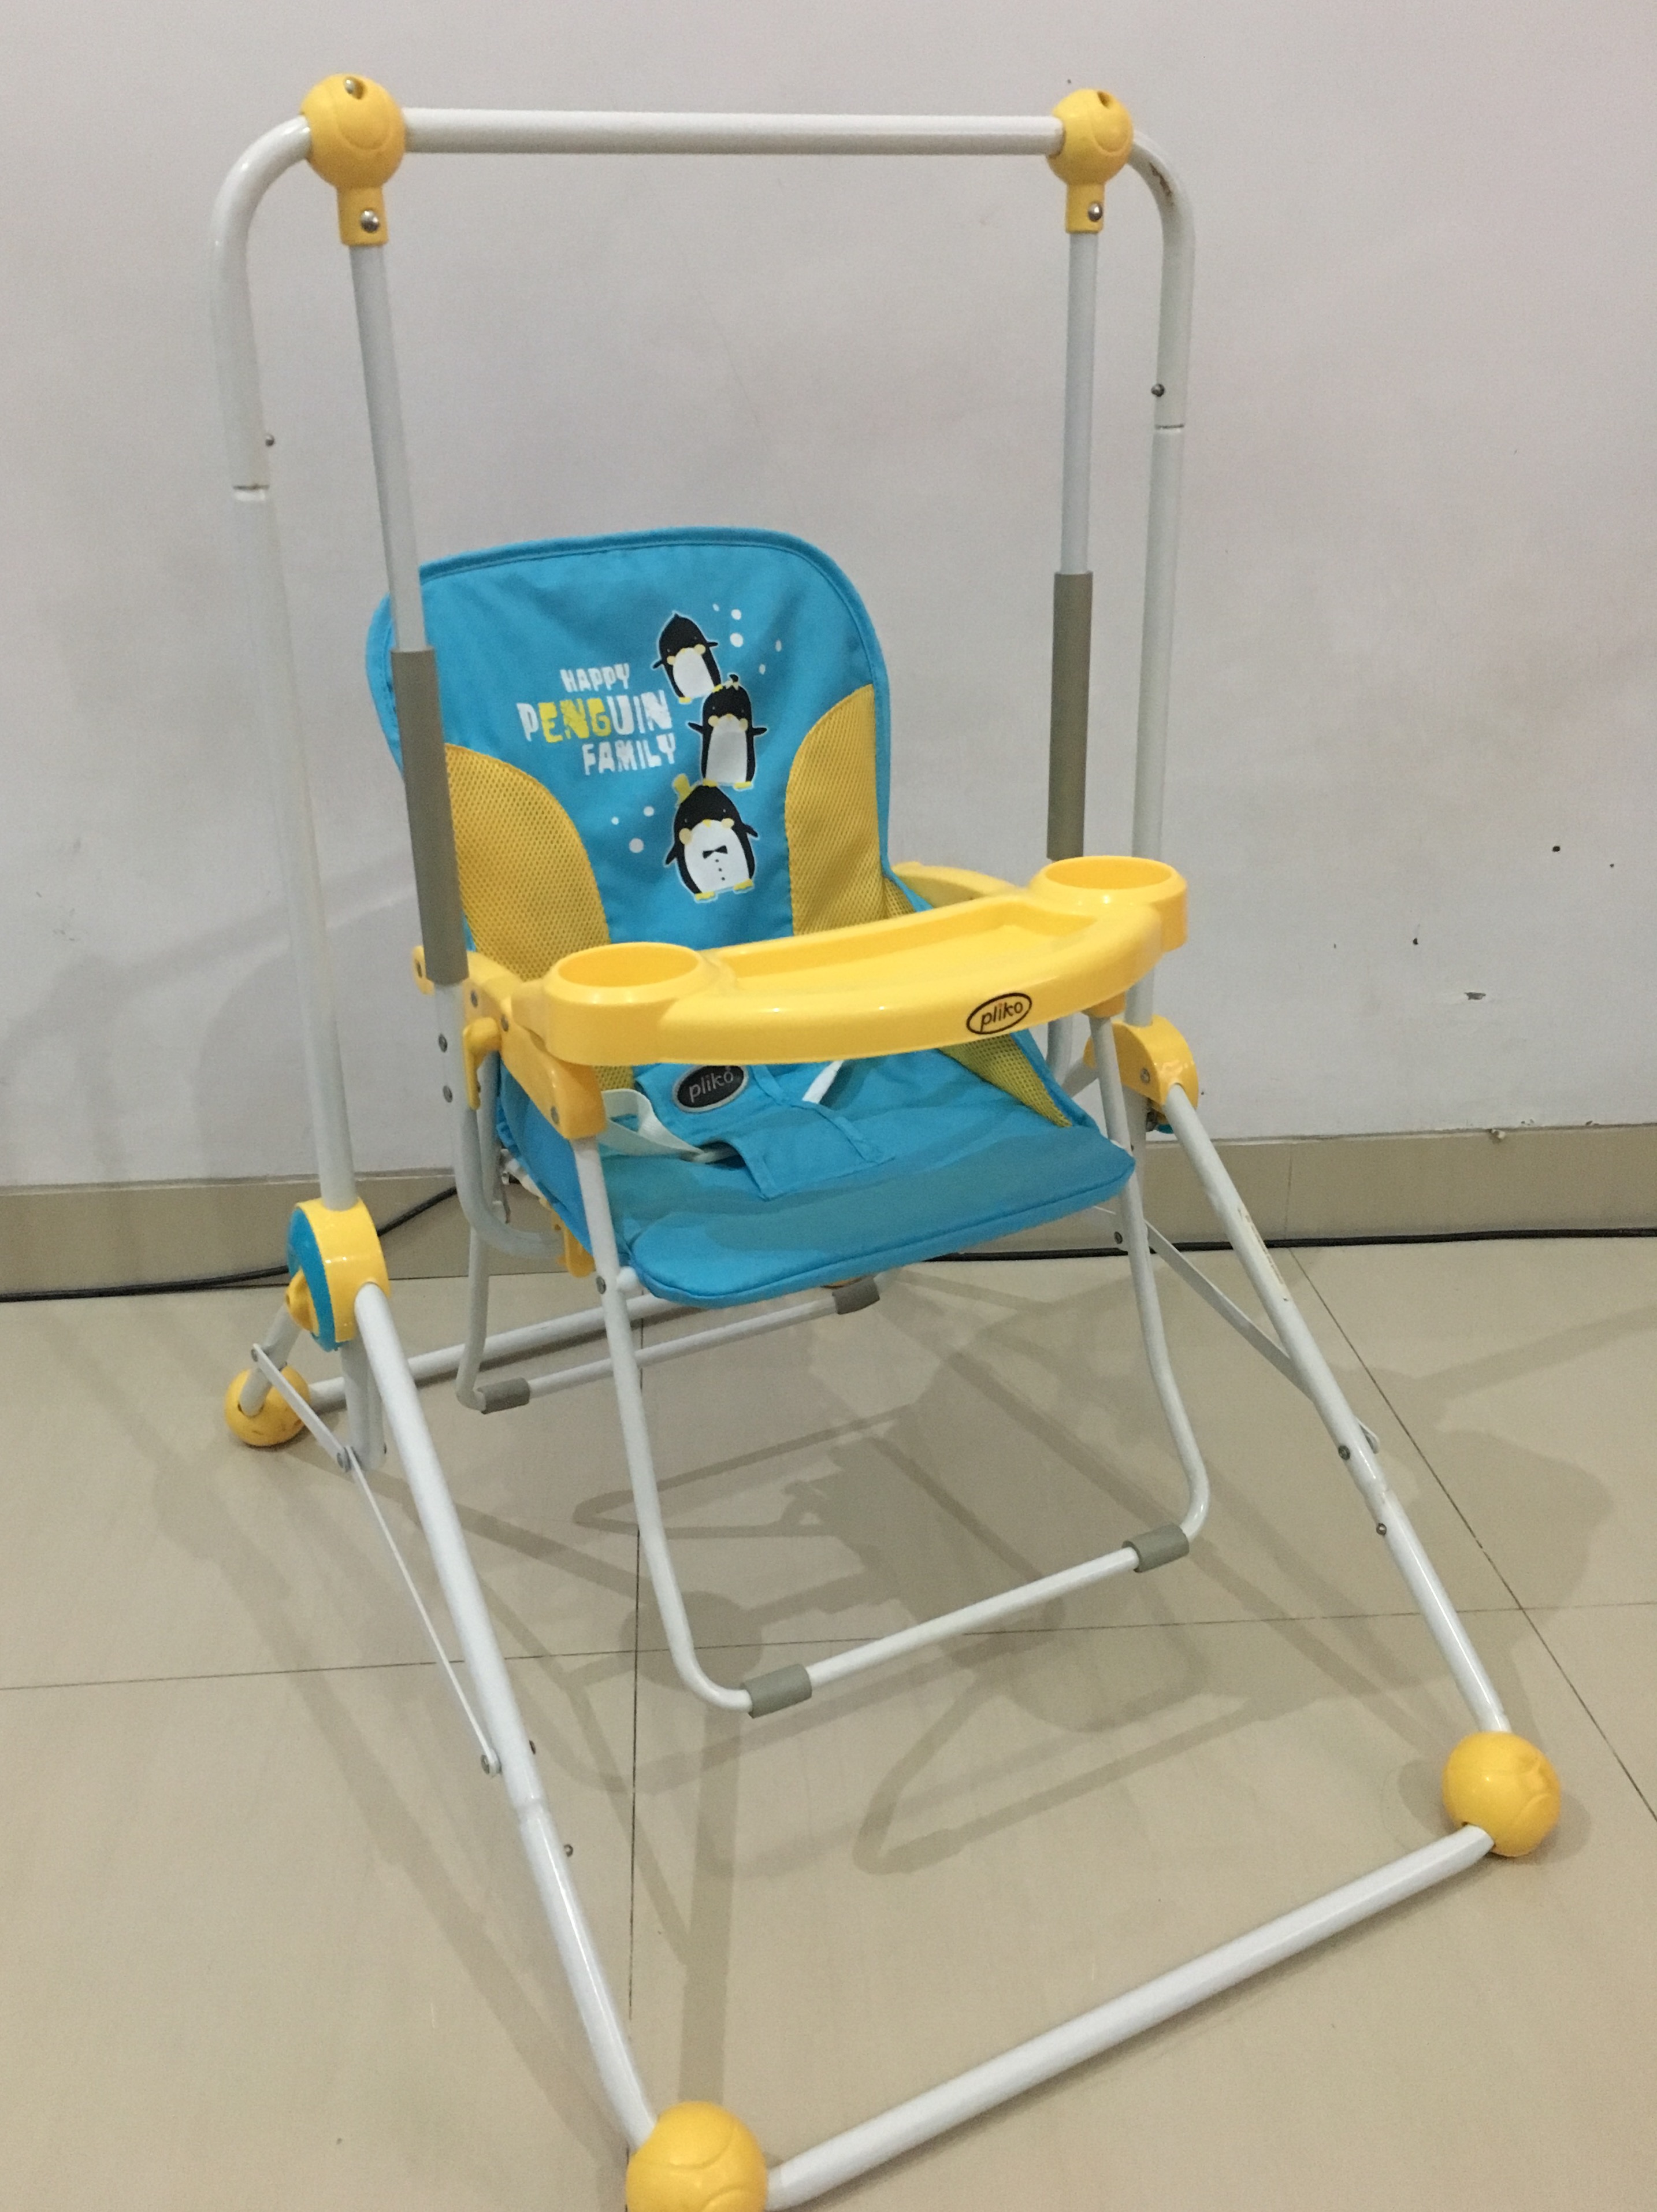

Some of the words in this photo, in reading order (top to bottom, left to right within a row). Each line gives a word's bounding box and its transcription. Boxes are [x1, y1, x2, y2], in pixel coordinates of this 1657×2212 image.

[559, 662, 630, 693] HAPPY
[516, 689, 673, 743] PENGUIN
[581, 732, 677, 776] FAMILY
[980, 1001, 1024, 1033] pliko
